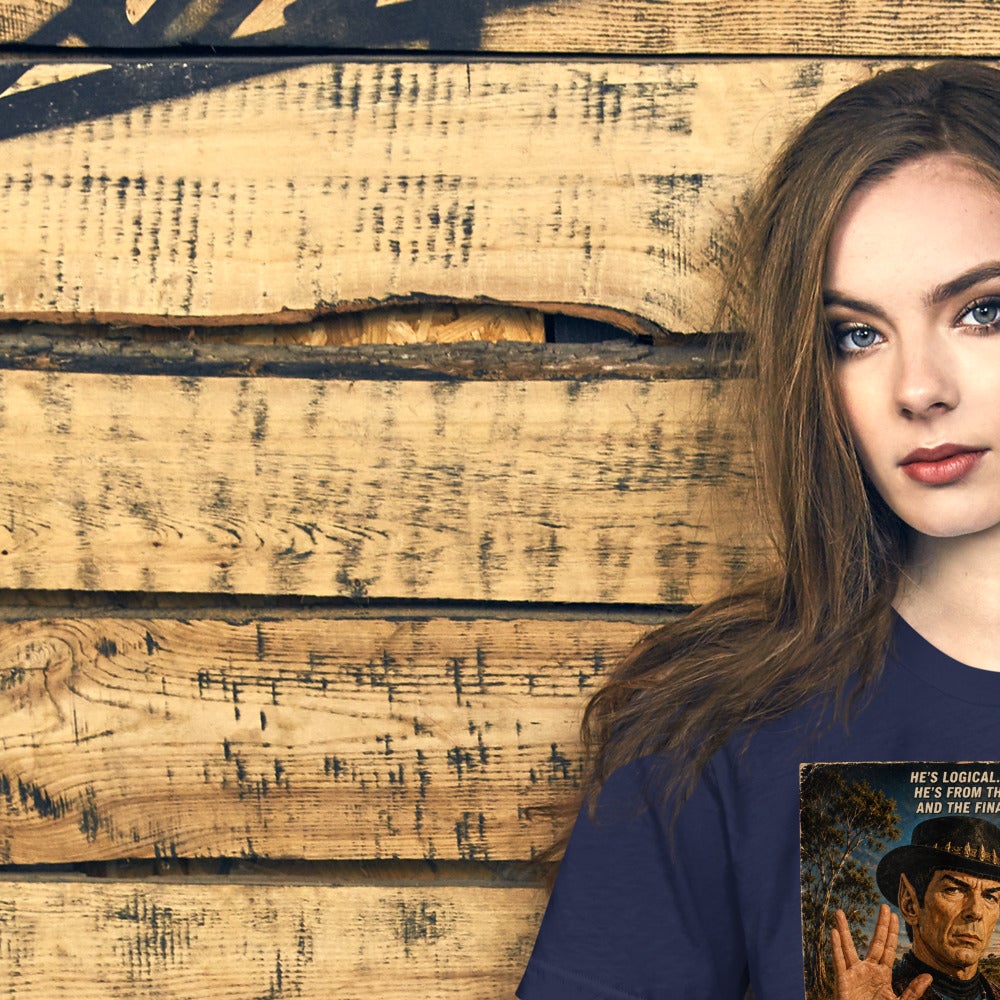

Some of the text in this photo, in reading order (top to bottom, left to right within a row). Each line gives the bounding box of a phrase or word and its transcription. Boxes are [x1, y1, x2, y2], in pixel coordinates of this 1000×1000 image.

[910, 771, 938, 784] HE'S
[942, 771, 1000, 784] LOGICAL.
[914, 786, 942, 799] HE'S
[946, 786, 982, 799] FROM
[916, 801, 943, 814] AND
[947, 801, 970, 814] THE
